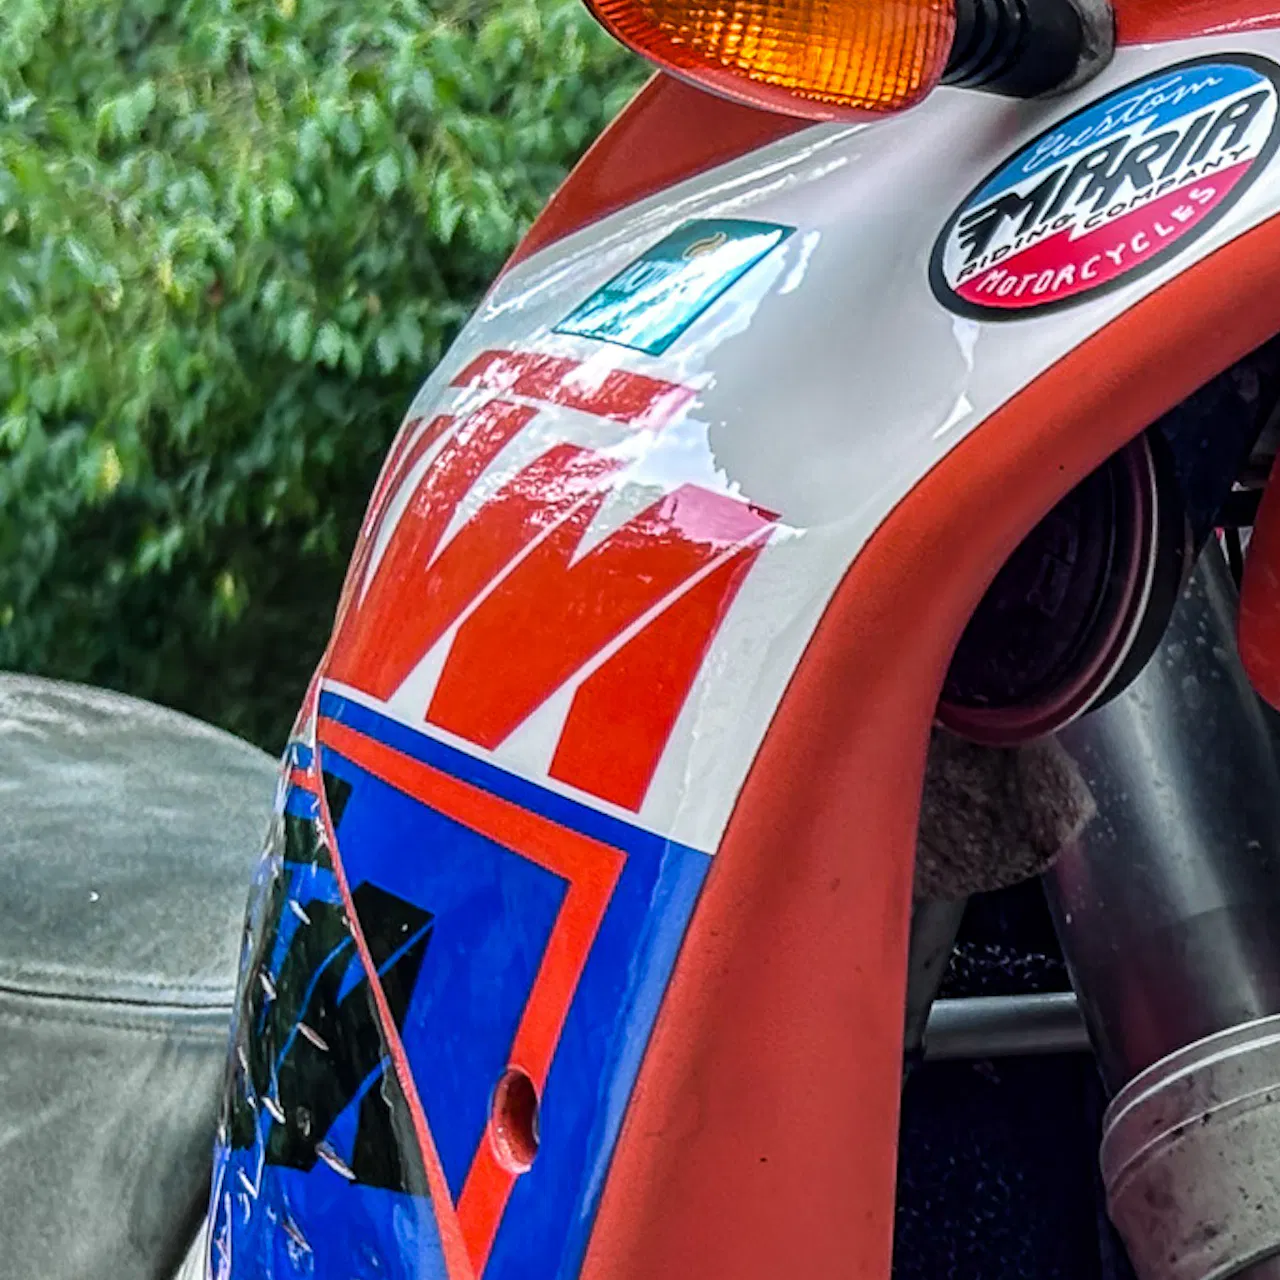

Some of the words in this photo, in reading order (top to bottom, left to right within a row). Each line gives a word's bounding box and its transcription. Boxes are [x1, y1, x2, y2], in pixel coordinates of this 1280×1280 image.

[958, 89, 1271, 265] MARIA
[1022, 77, 1224, 173] Custom
[956, 213, 1076, 282] RIDING
[1084, 145, 1252, 229] COMPANY
[976, 187, 1217, 297] MOTORCYCLES
